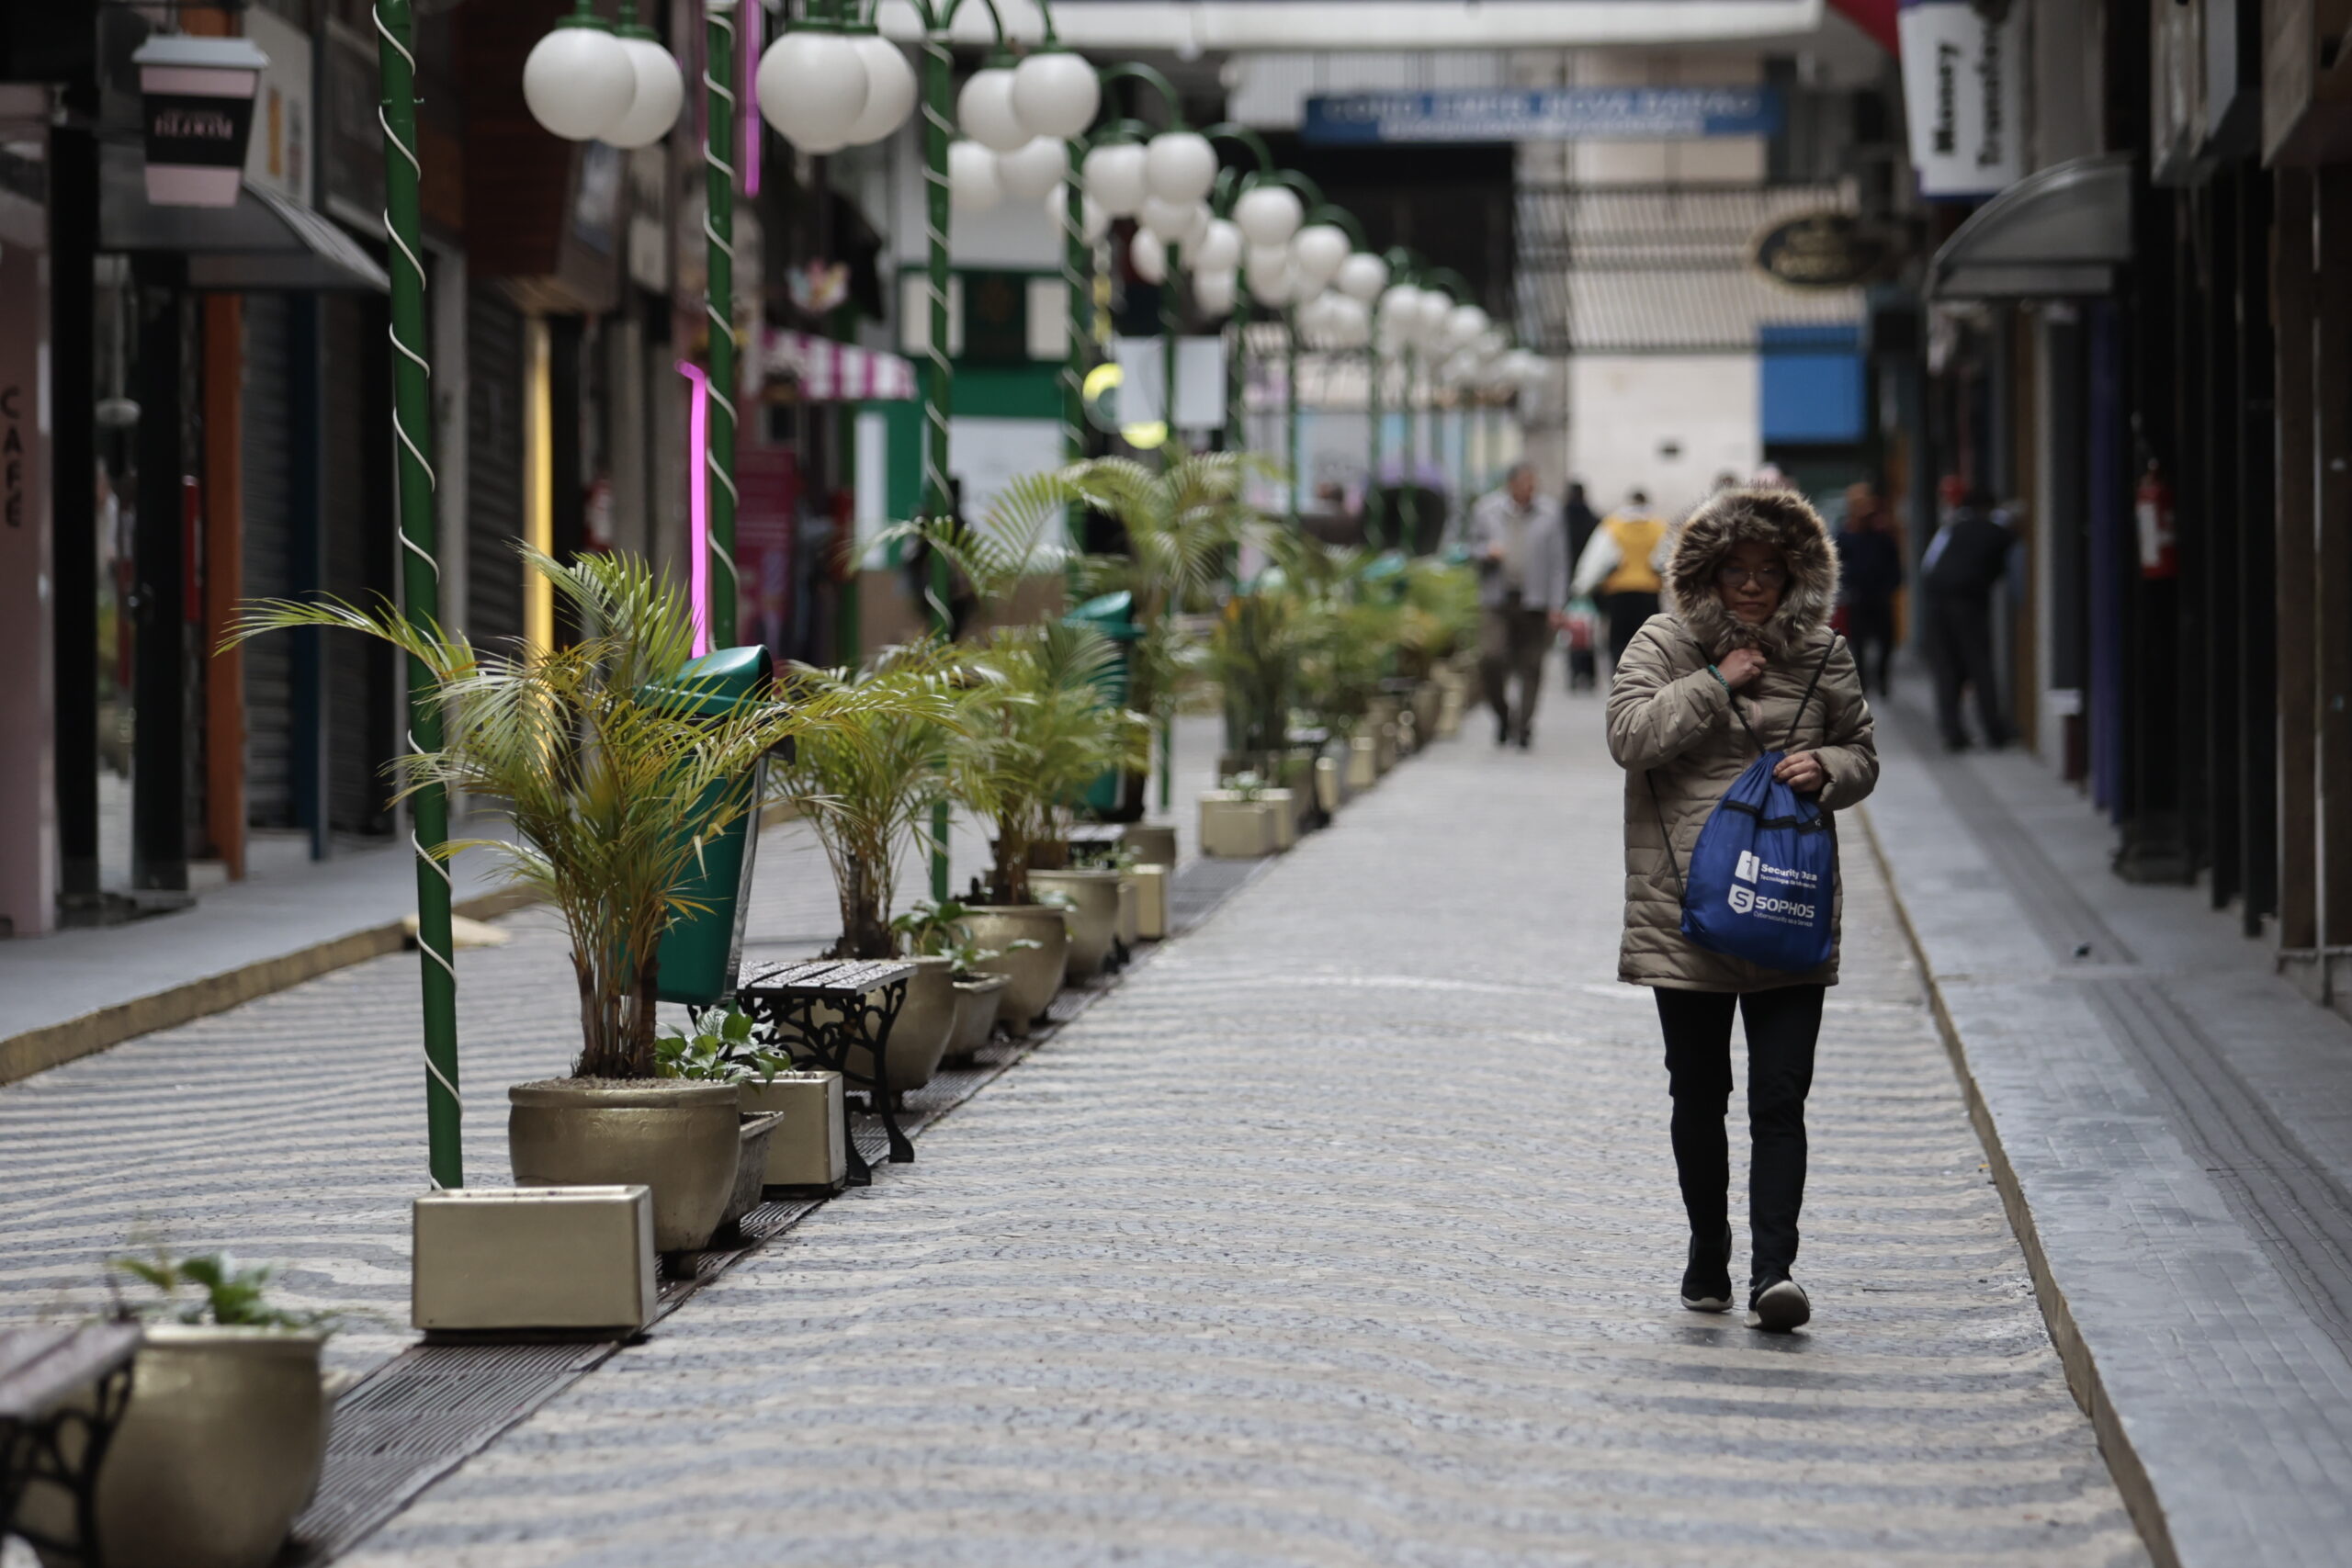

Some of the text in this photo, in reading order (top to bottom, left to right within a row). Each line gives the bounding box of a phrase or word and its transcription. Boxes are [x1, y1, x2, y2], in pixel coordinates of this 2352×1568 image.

[1934, 42, 1960, 154] Money
[1761, 863, 1799, 879] Security
[1753, 910, 1787, 923] Cybersecurity
[1755, 896, 1815, 919] SOPHOS
